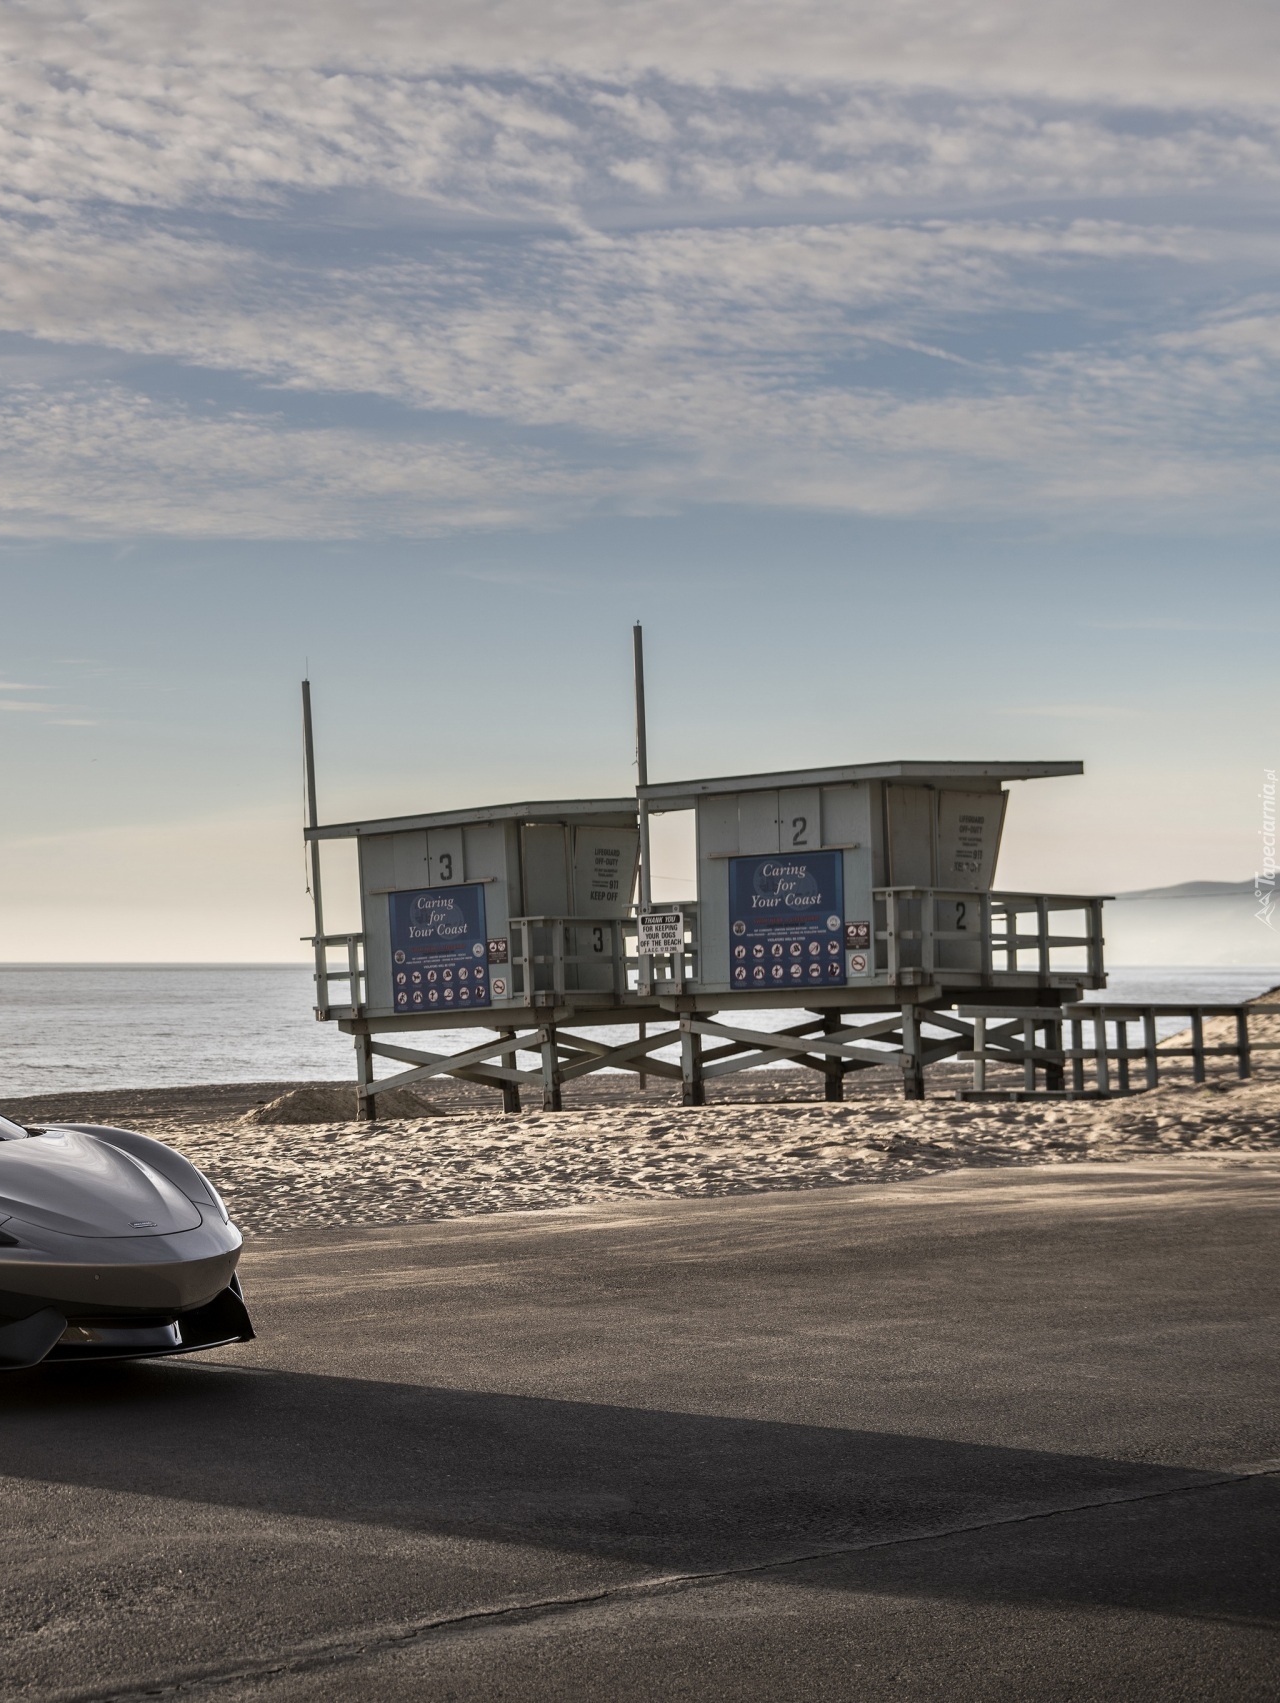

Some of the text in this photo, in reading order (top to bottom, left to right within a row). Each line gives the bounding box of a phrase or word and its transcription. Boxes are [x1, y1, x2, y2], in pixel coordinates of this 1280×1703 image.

[792, 817, 807, 846] 2
[595, 848, 620, 857] LIFEGUARD
[440, 854, 452, 880] 3
[595, 858, 618, 866] OFF-DUTY
[762, 862, 806, 878] Caring
[609, 880, 618, 889] 911
[774, 878, 796, 895] for
[417, 896, 454, 910] Caring
[591, 891, 618, 901] KEEP OFF
[751, 893, 821, 908] Your Coast
[427, 911, 446, 925] for
[644, 915, 676, 924] THANK YOU
[956, 902, 966, 929] 2
[409, 923, 468, 938] Your Coast
[593, 928, 603, 952] 3
